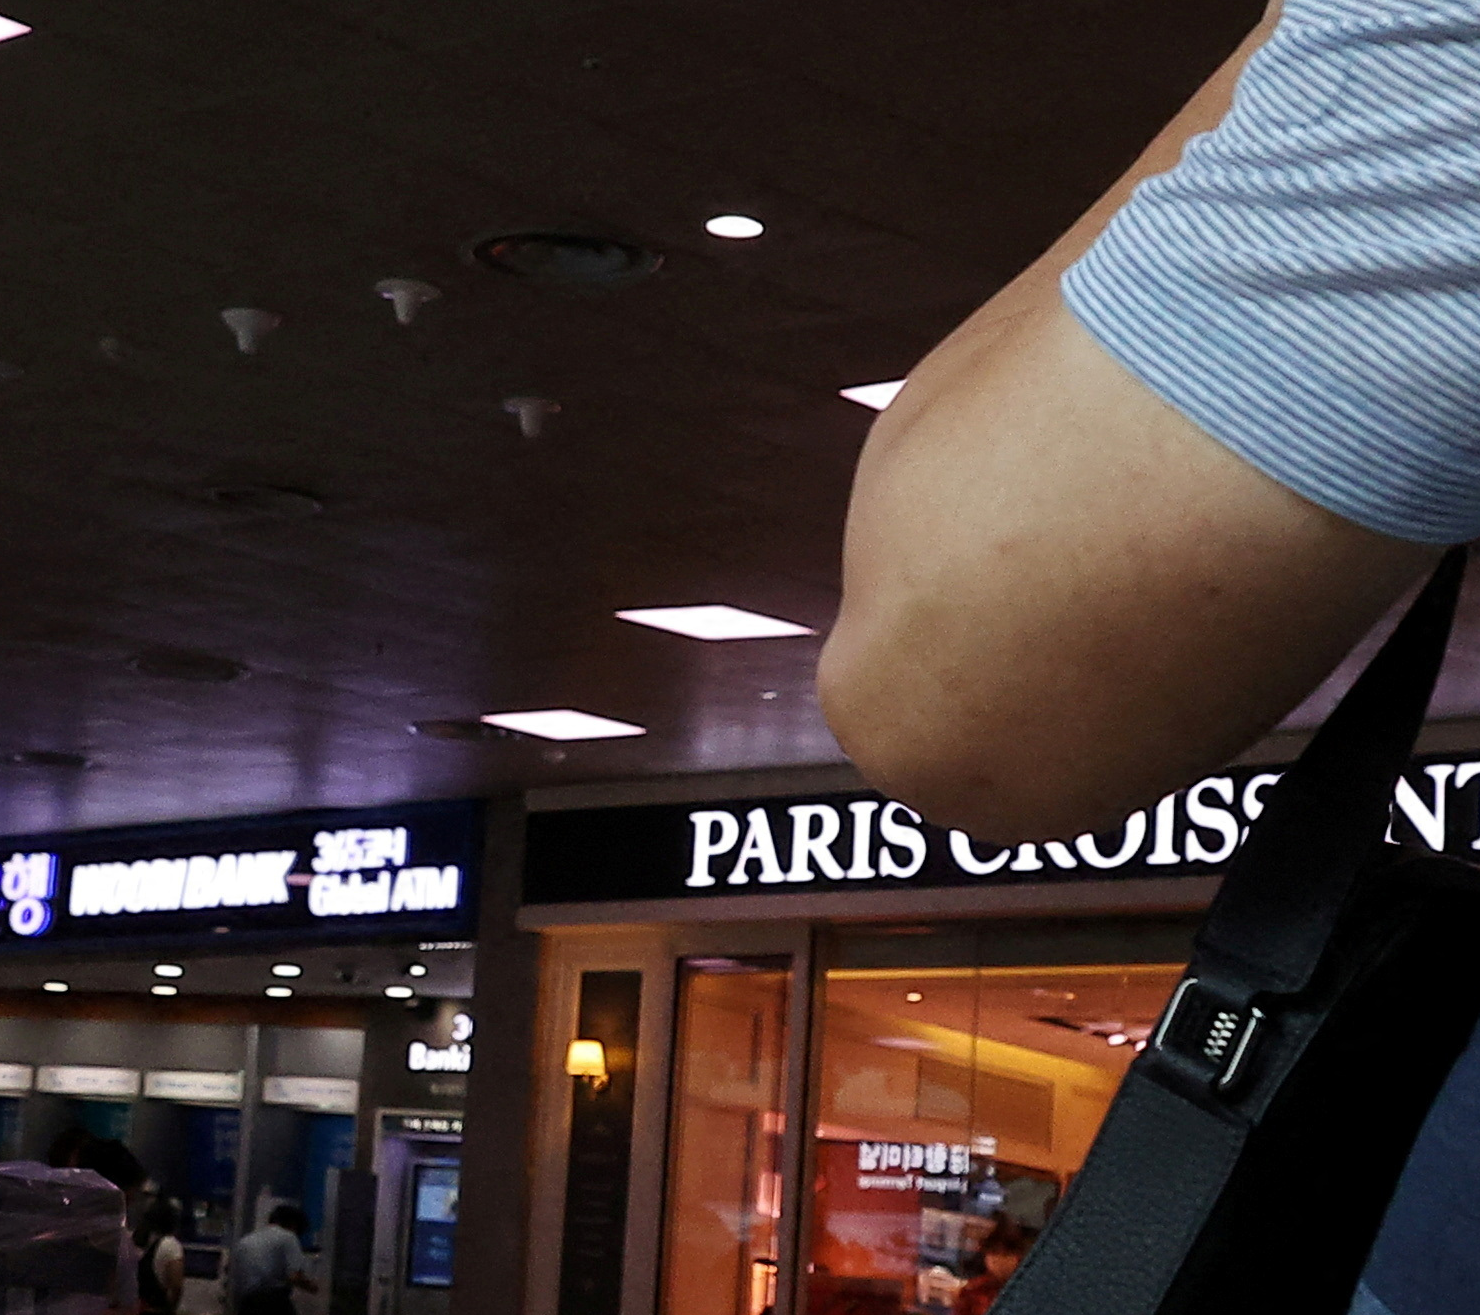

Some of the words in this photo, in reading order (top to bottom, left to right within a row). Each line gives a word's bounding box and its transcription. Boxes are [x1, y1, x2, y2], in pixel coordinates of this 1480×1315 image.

[685, 799, 927, 887] PARIS
[391, 866, 459, 911] ATM
[408, 1041, 472, 1072] Banki
